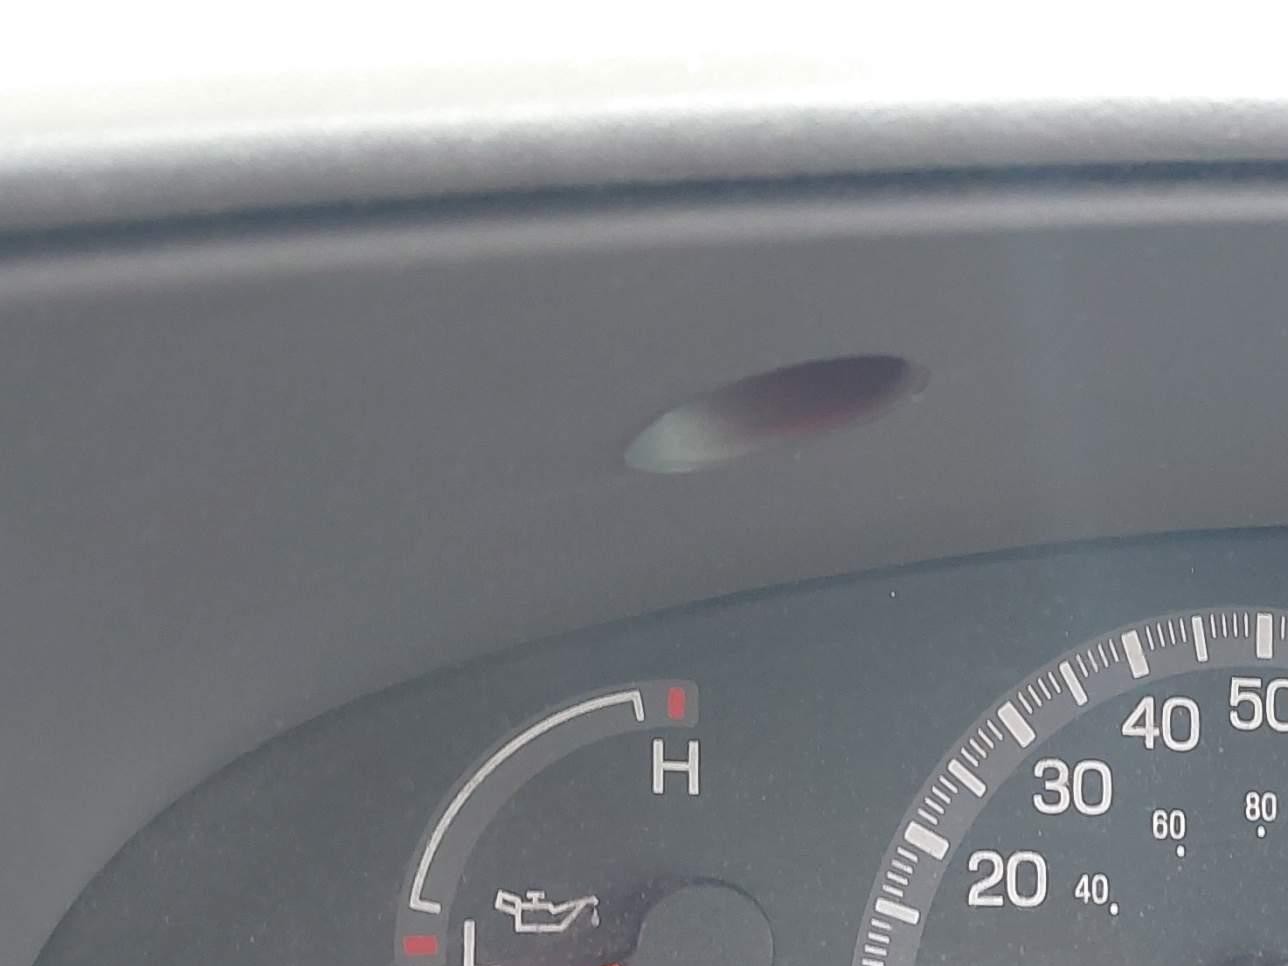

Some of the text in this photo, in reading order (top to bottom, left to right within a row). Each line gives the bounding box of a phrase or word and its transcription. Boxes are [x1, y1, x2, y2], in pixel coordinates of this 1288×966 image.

[1121, 696, 1200, 751] 40
[652, 739, 699, 795] H
[1032, 758, 1113, 816] 30
[1152, 809, 1186, 840] 60
[1245, 791, 1277, 822] 80
[968, 850, 1048, 908] 20
[1075, 873, 1109, 906] 40
